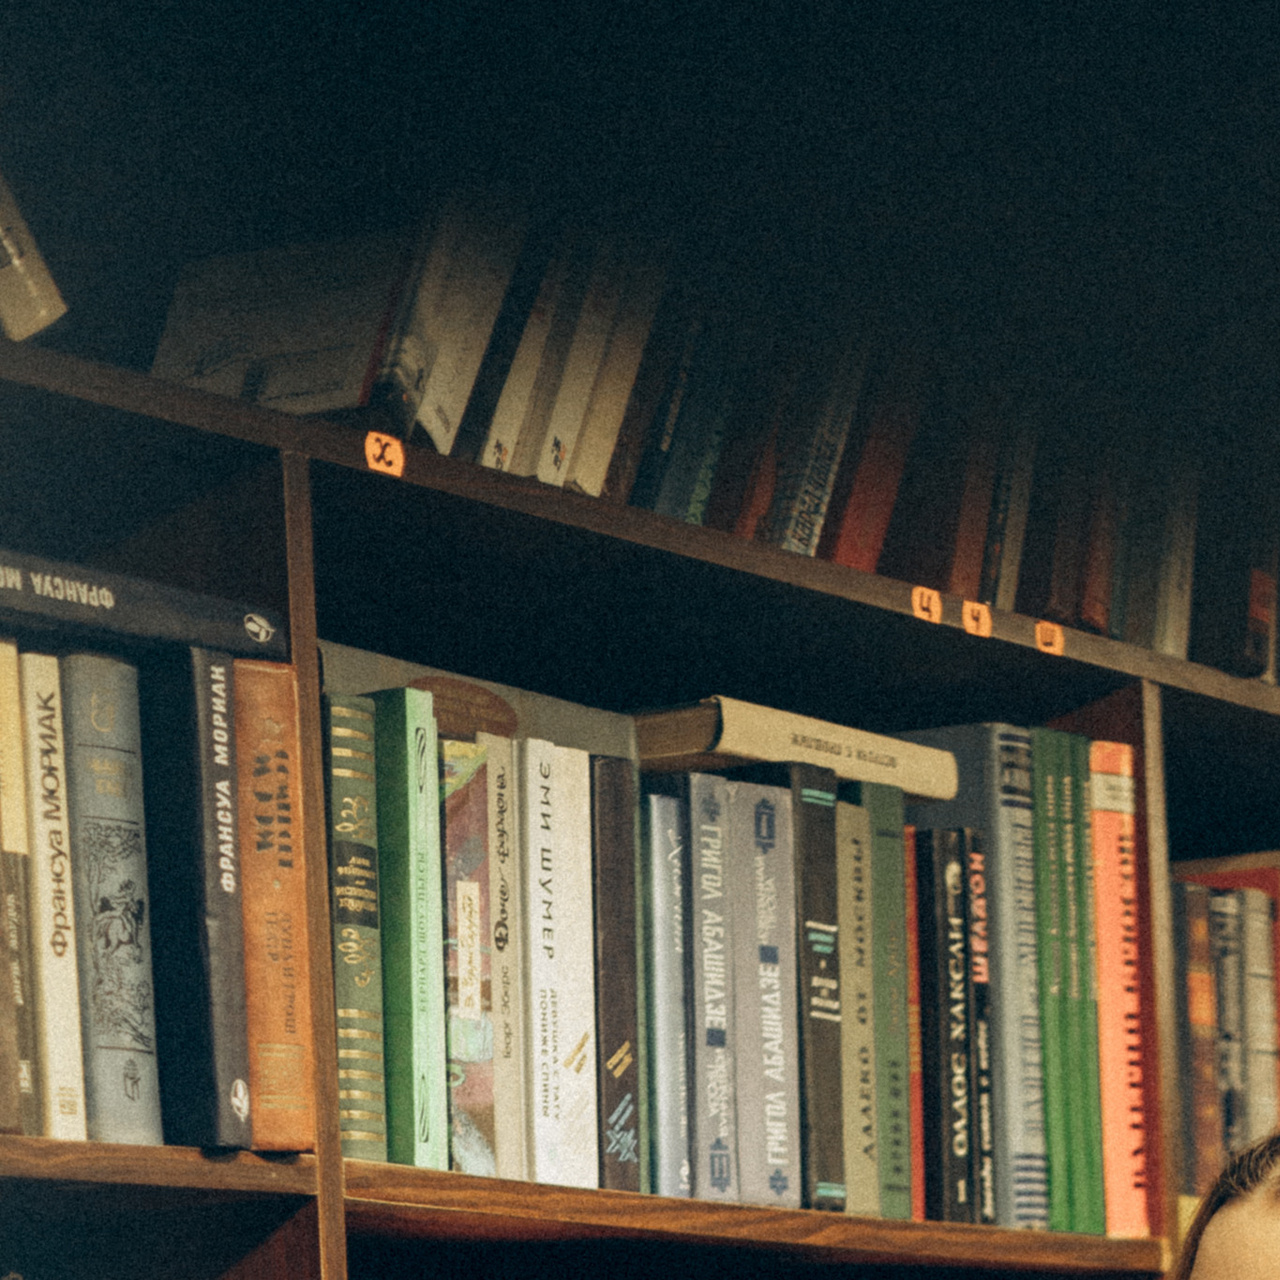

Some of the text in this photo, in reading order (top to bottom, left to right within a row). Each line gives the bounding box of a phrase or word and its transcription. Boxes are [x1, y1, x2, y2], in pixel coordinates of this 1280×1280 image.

[30, 572, 115, 609] ФРАНСУА
[36, 691, 73, 958] Франсуа МОРИАК
[210, 665, 237, 893] ФРАНСУА МОРИАК
[416, 851, 428, 903] ПЬЕСЫ
[494, 872, 511, 952] Дочь
[539, 762, 554, 959] ЭМИ ШУМЕР
[699, 825, 722, 900] ГРИГОЛ
[969, 852, 990, 983] ШЕЛДОН
[417, 912, 428, 944] ШОУ
[702, 908, 727, 1029] АБАШИДЗЕ
[502, 1023, 514, 1060] Георг
[540, 988, 551, 1118] ПОНИЖЕ СПИНЫ
[549, 988, 559, 1065] ДЕВУШКА
[759, 964, 785, 1082] АБАШИДЗЕ
[851, 838, 875, 1161] ДАЛЕКО ОТ МОСКВЫ
[948, 916, 968, 1157] ОЛДОС ХАКСЛИ
[766, 1091, 789, 1166] ГРИГОЛ
